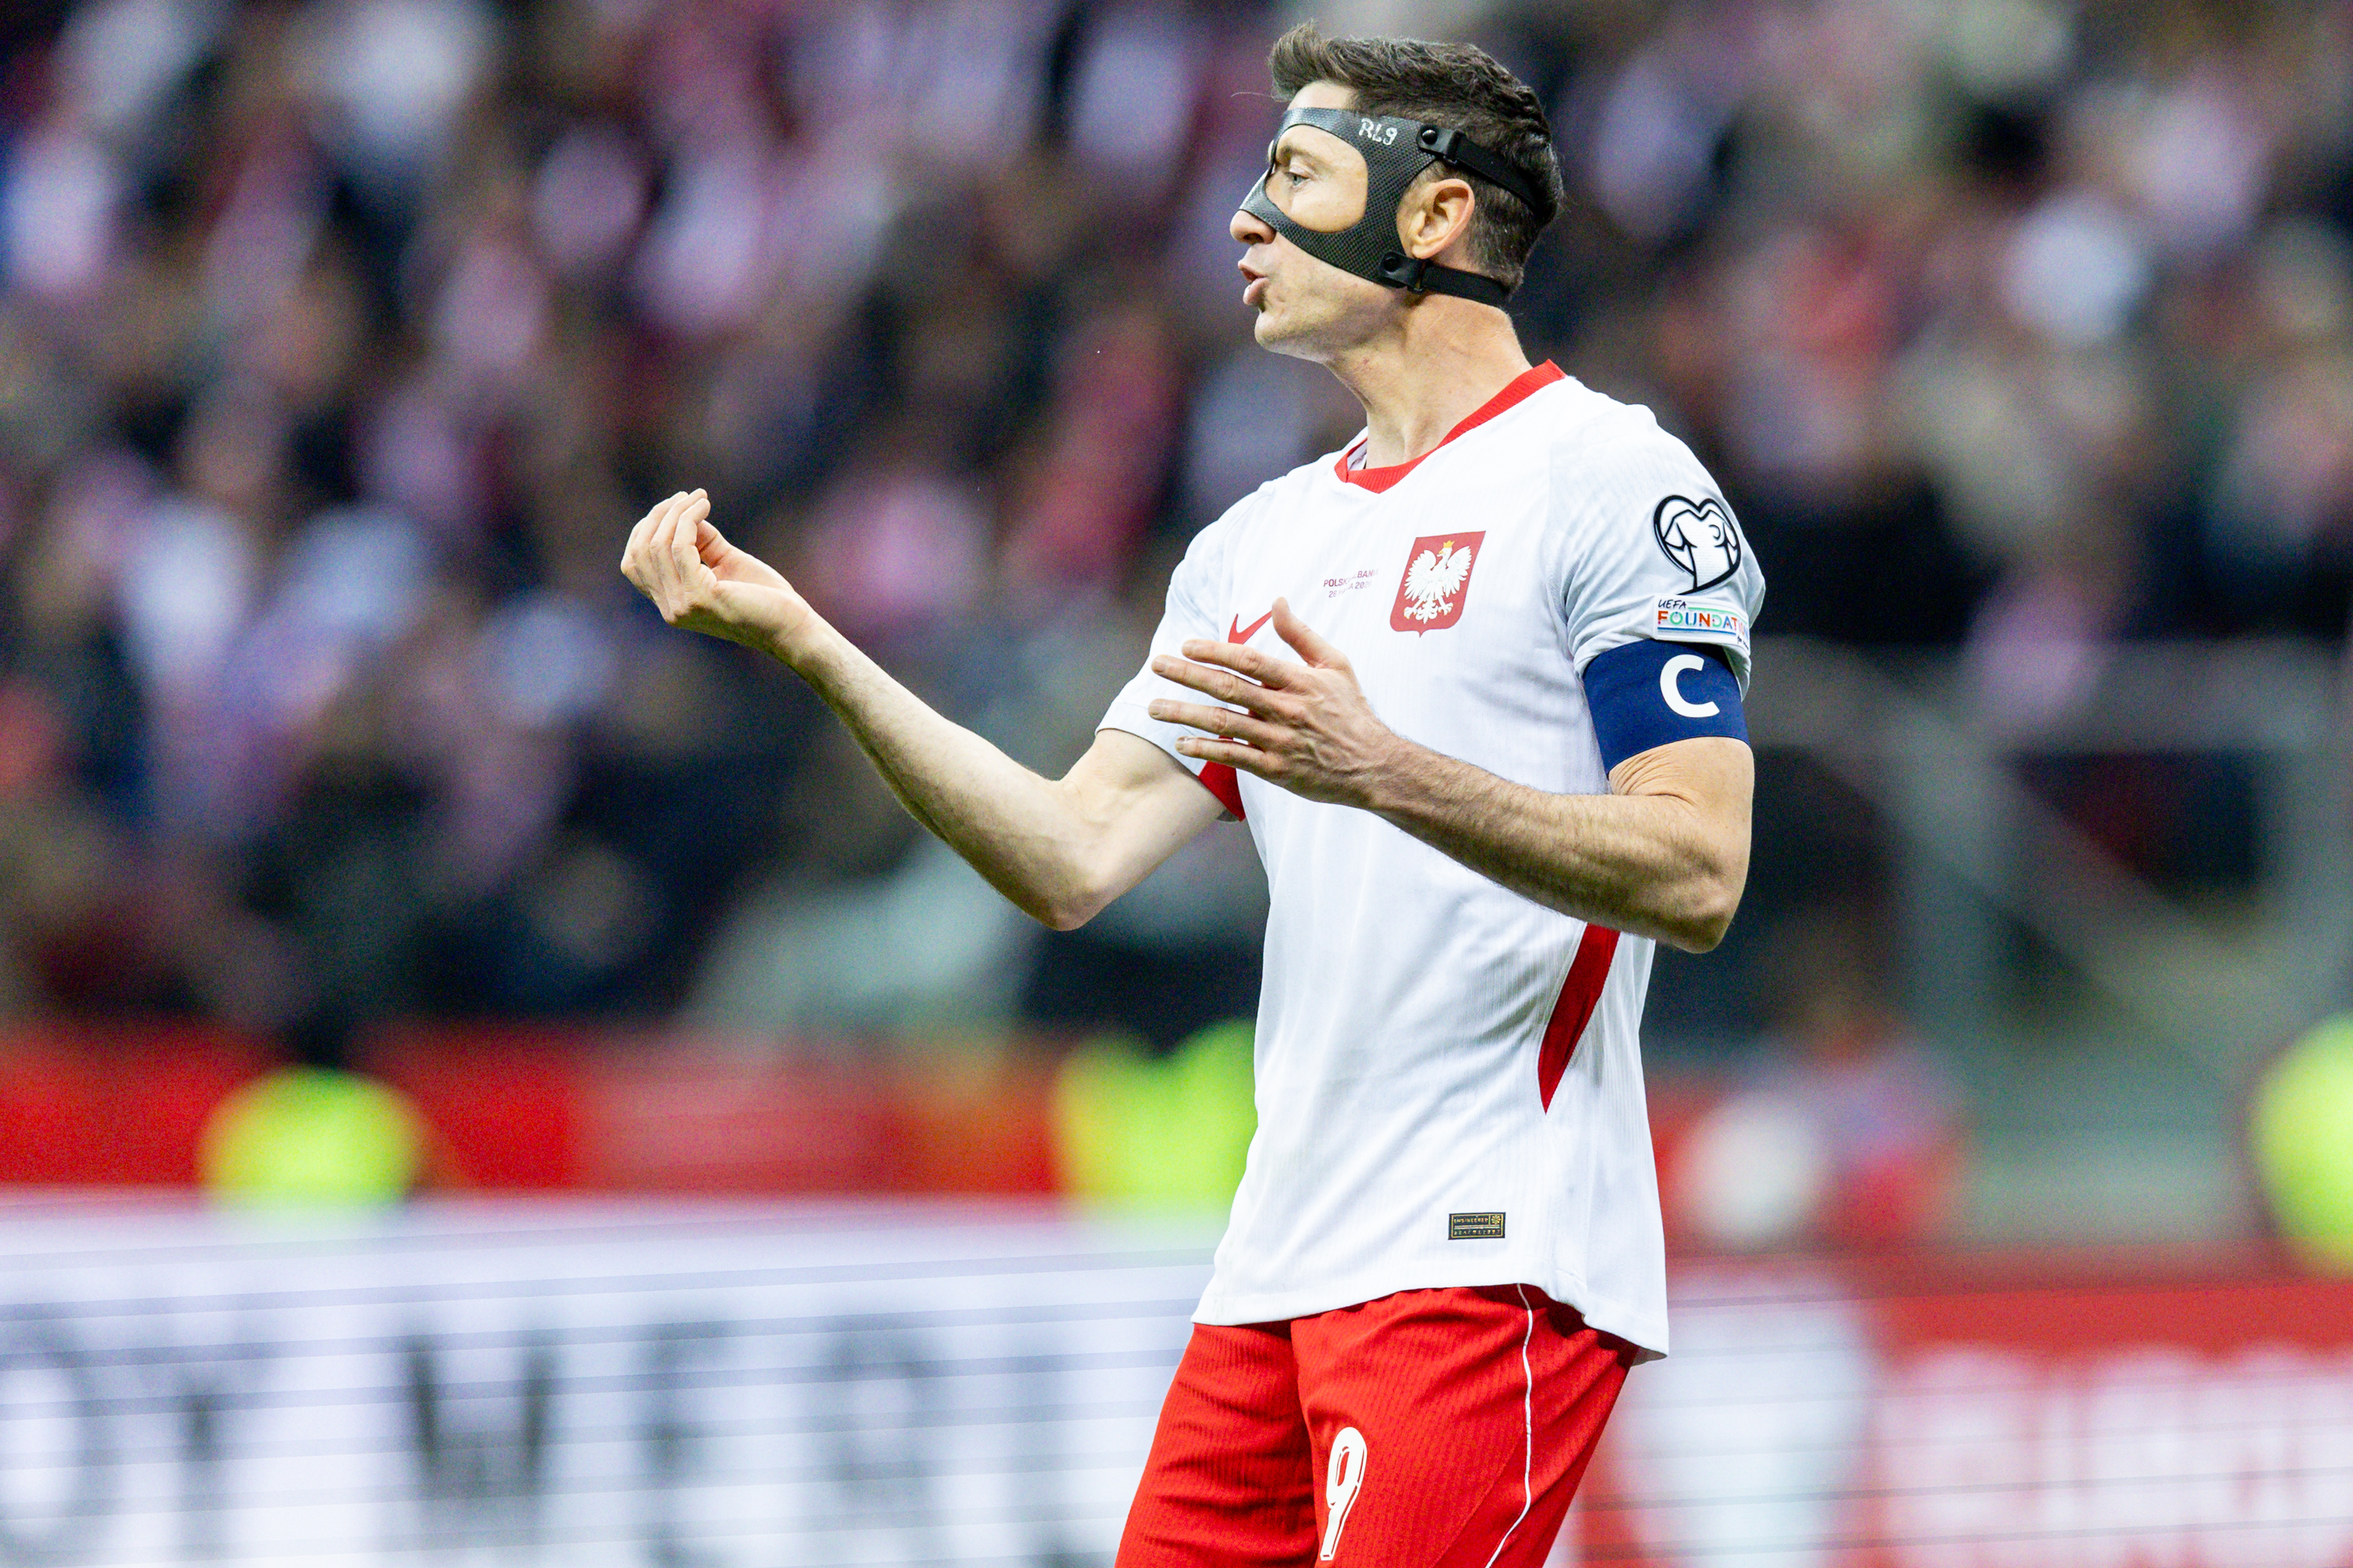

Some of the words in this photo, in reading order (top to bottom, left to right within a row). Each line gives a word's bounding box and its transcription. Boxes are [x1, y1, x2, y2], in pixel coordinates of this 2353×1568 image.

[1359, 117, 1398, 146] RL9
[1658, 599, 1687, 609] UEFA
[1659, 654, 1720, 718] C
[1319, 1427, 1367, 1561] 9
